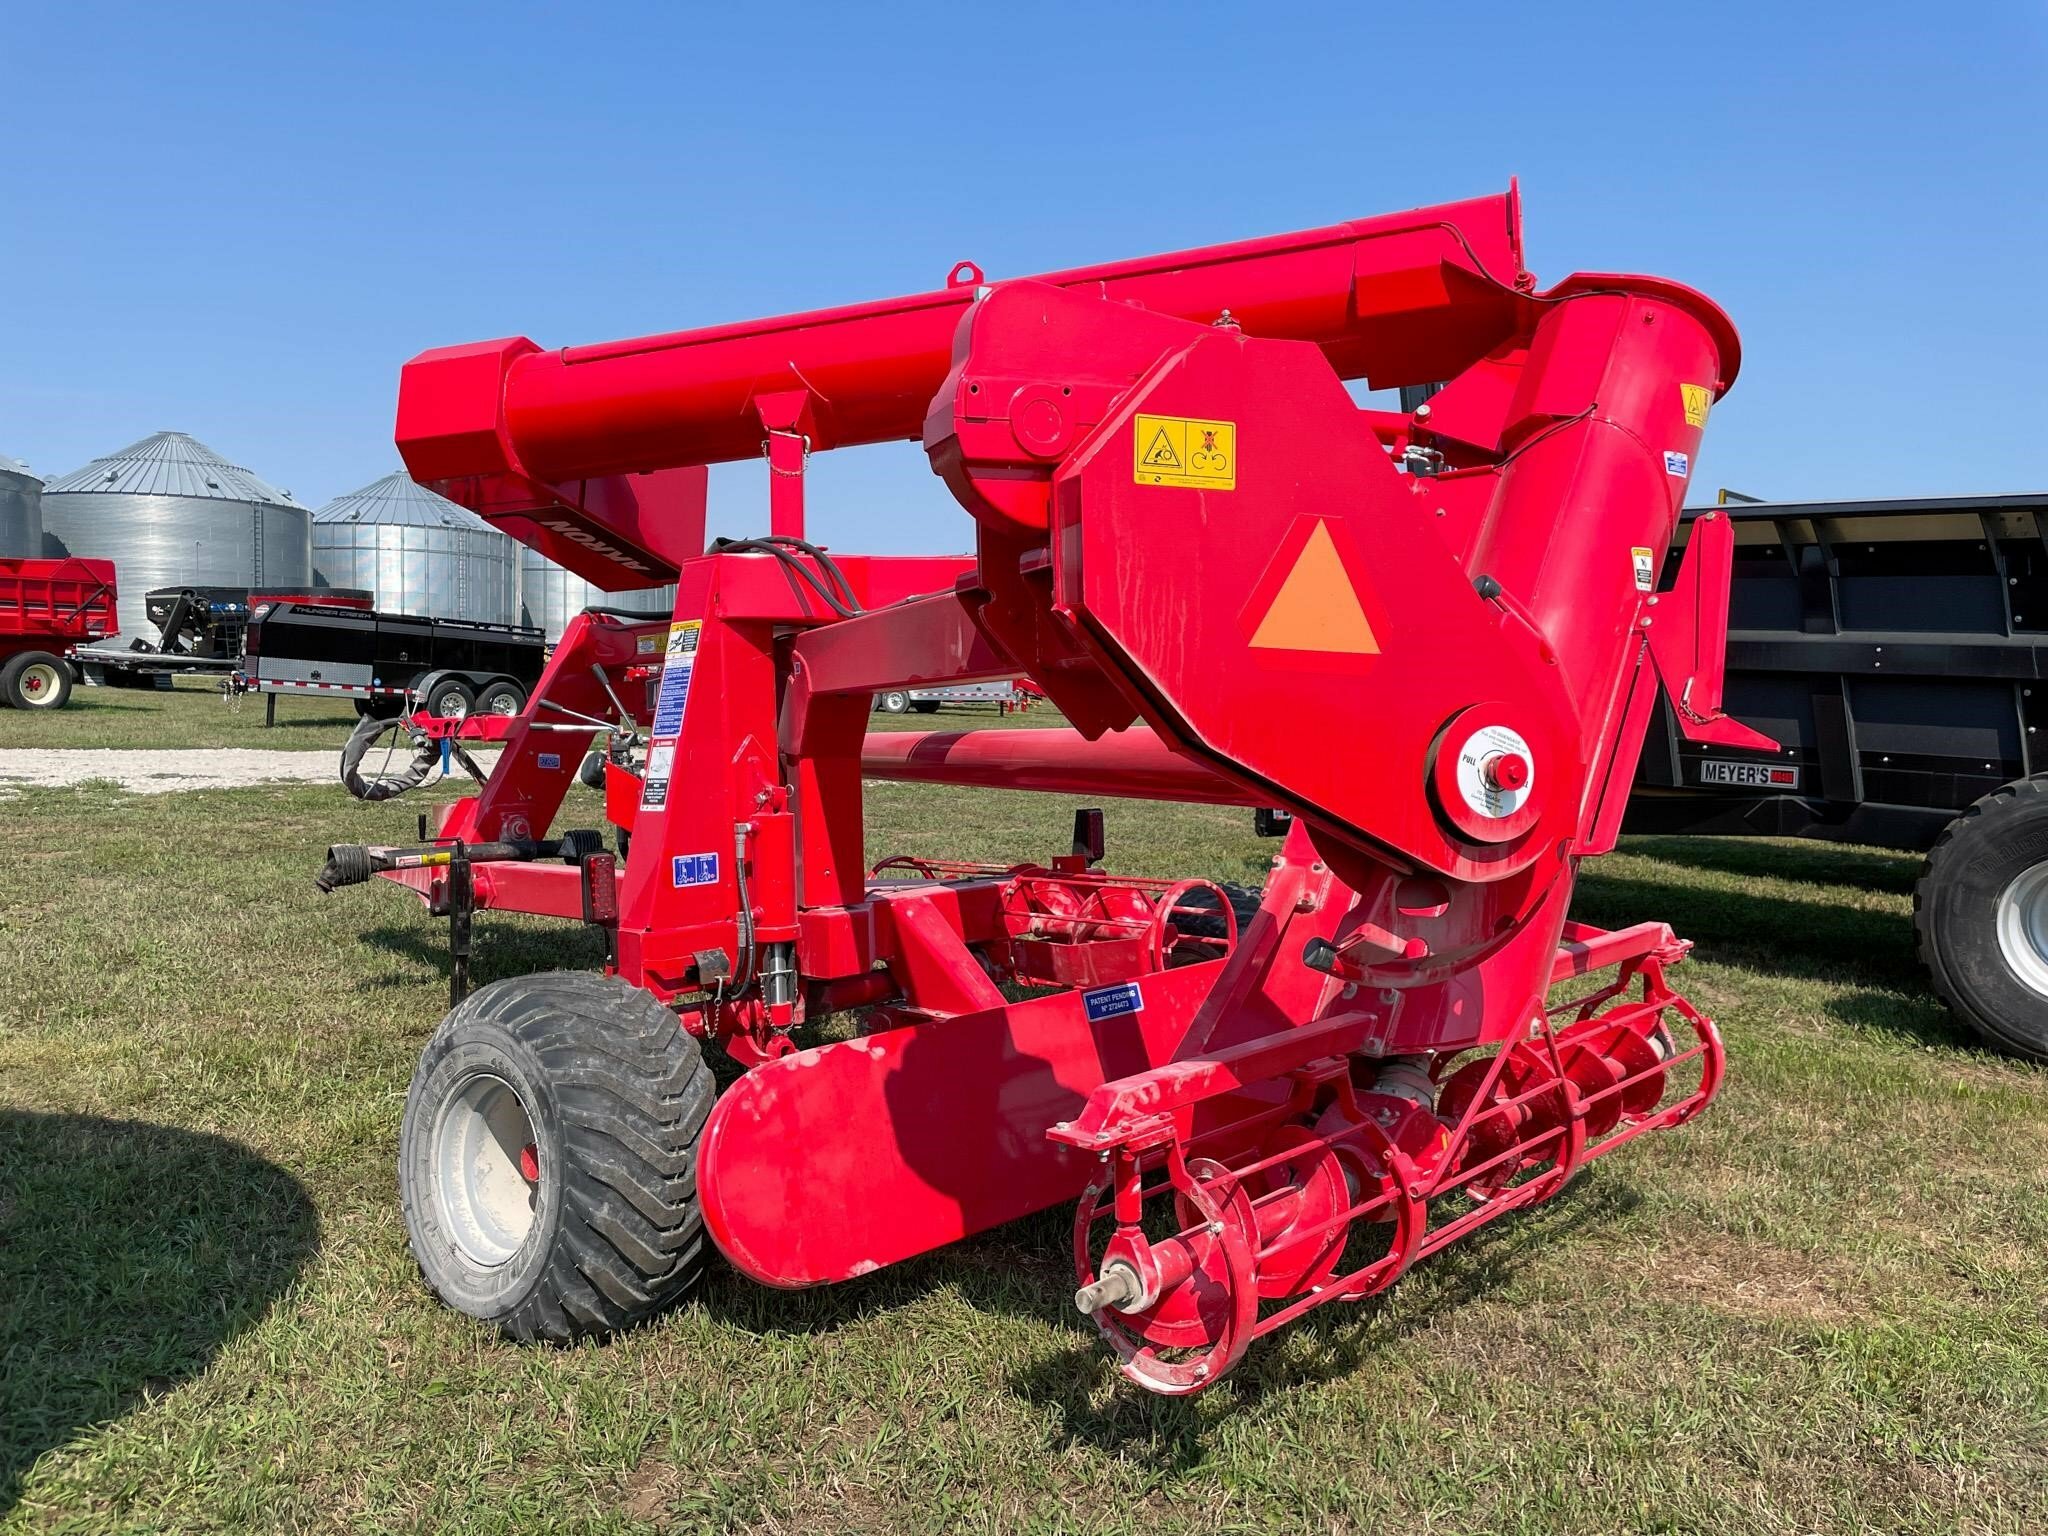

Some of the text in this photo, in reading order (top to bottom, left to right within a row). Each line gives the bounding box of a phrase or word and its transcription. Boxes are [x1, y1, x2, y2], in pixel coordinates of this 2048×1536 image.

[539, 520, 652, 571] AKRON
[295, 606, 338, 616] THUNDER
[1462, 754, 1476, 766] PULL
[1705, 763, 1769, 783] MEYER'S
[1091, 990, 1136, 1006] PATENT PENDING
